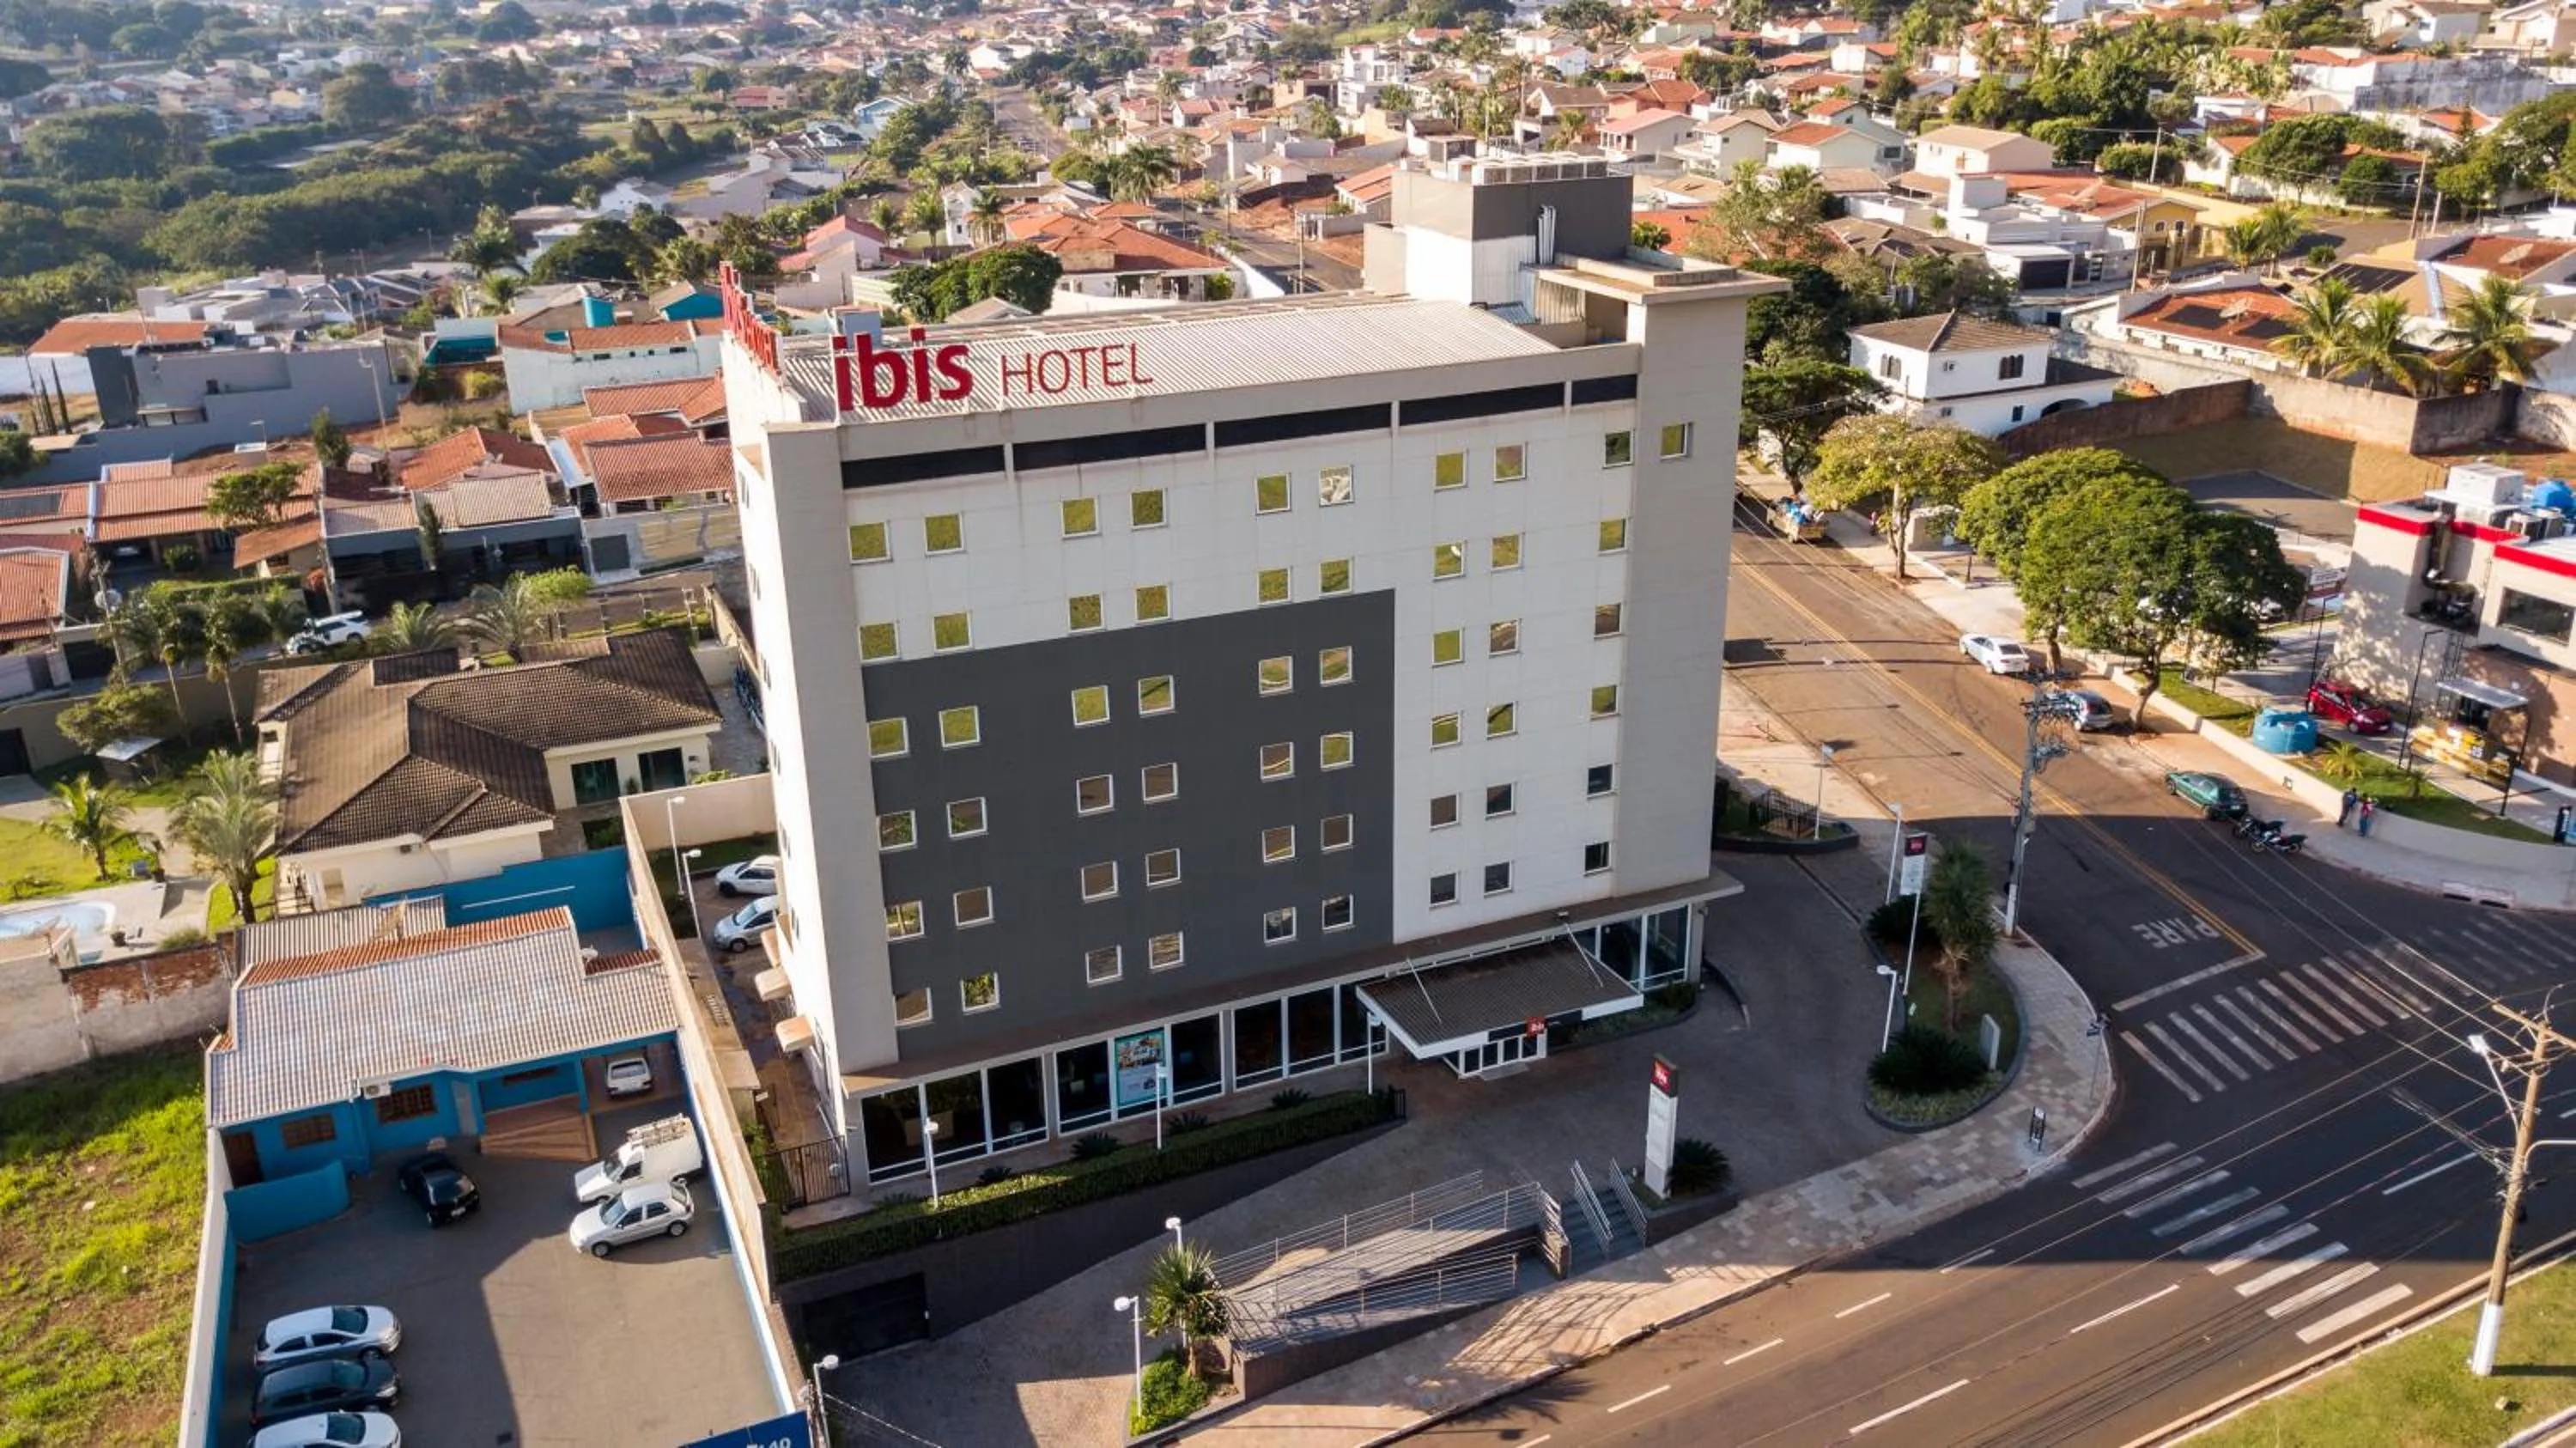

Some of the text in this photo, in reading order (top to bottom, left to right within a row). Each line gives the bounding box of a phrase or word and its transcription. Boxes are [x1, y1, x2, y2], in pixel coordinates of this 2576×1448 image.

[834, 328, 1153, 411] ibis HOTEL
[2131, 915, 2220, 948] PARE
